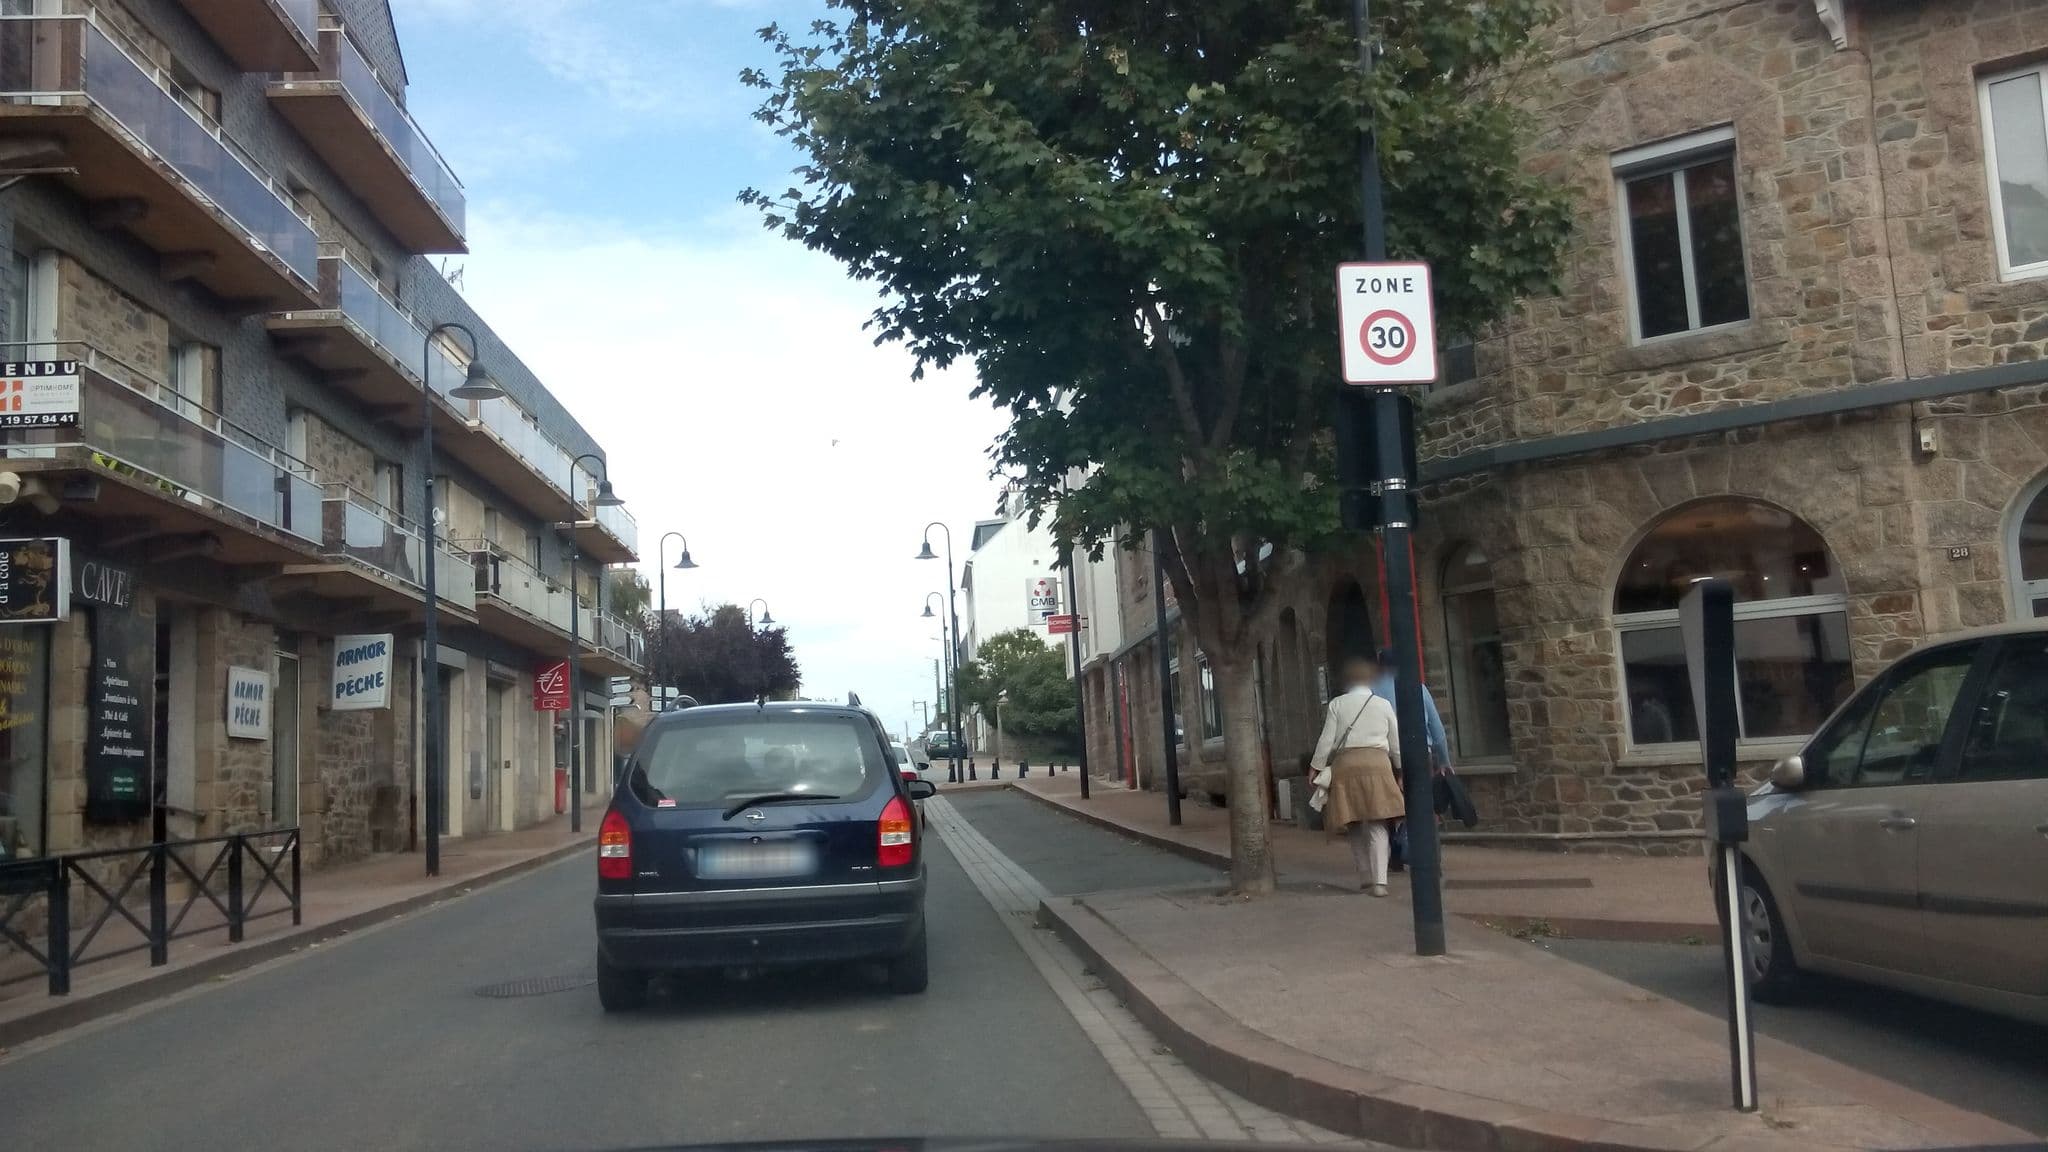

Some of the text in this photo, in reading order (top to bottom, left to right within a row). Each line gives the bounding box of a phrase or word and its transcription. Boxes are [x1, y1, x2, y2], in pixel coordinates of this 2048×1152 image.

[1355, 278, 1413, 293] ZONE
[1371, 326, 1405, 349] 30
[6, 416, 20, 424] 19
[24, 415, 38, 424] 57
[42, 415, 57, 423] 94
[60, 414, 74, 423] 41
[1952, 547, 1969, 558] 28
[82, 562, 127, 606] CAVE
[1031, 597, 1056, 607] CMB
[336, 640, 386, 668] ARMOR
[234, 681, 264, 701] ARMOR
[335, 671, 385, 699] PÊCHE
